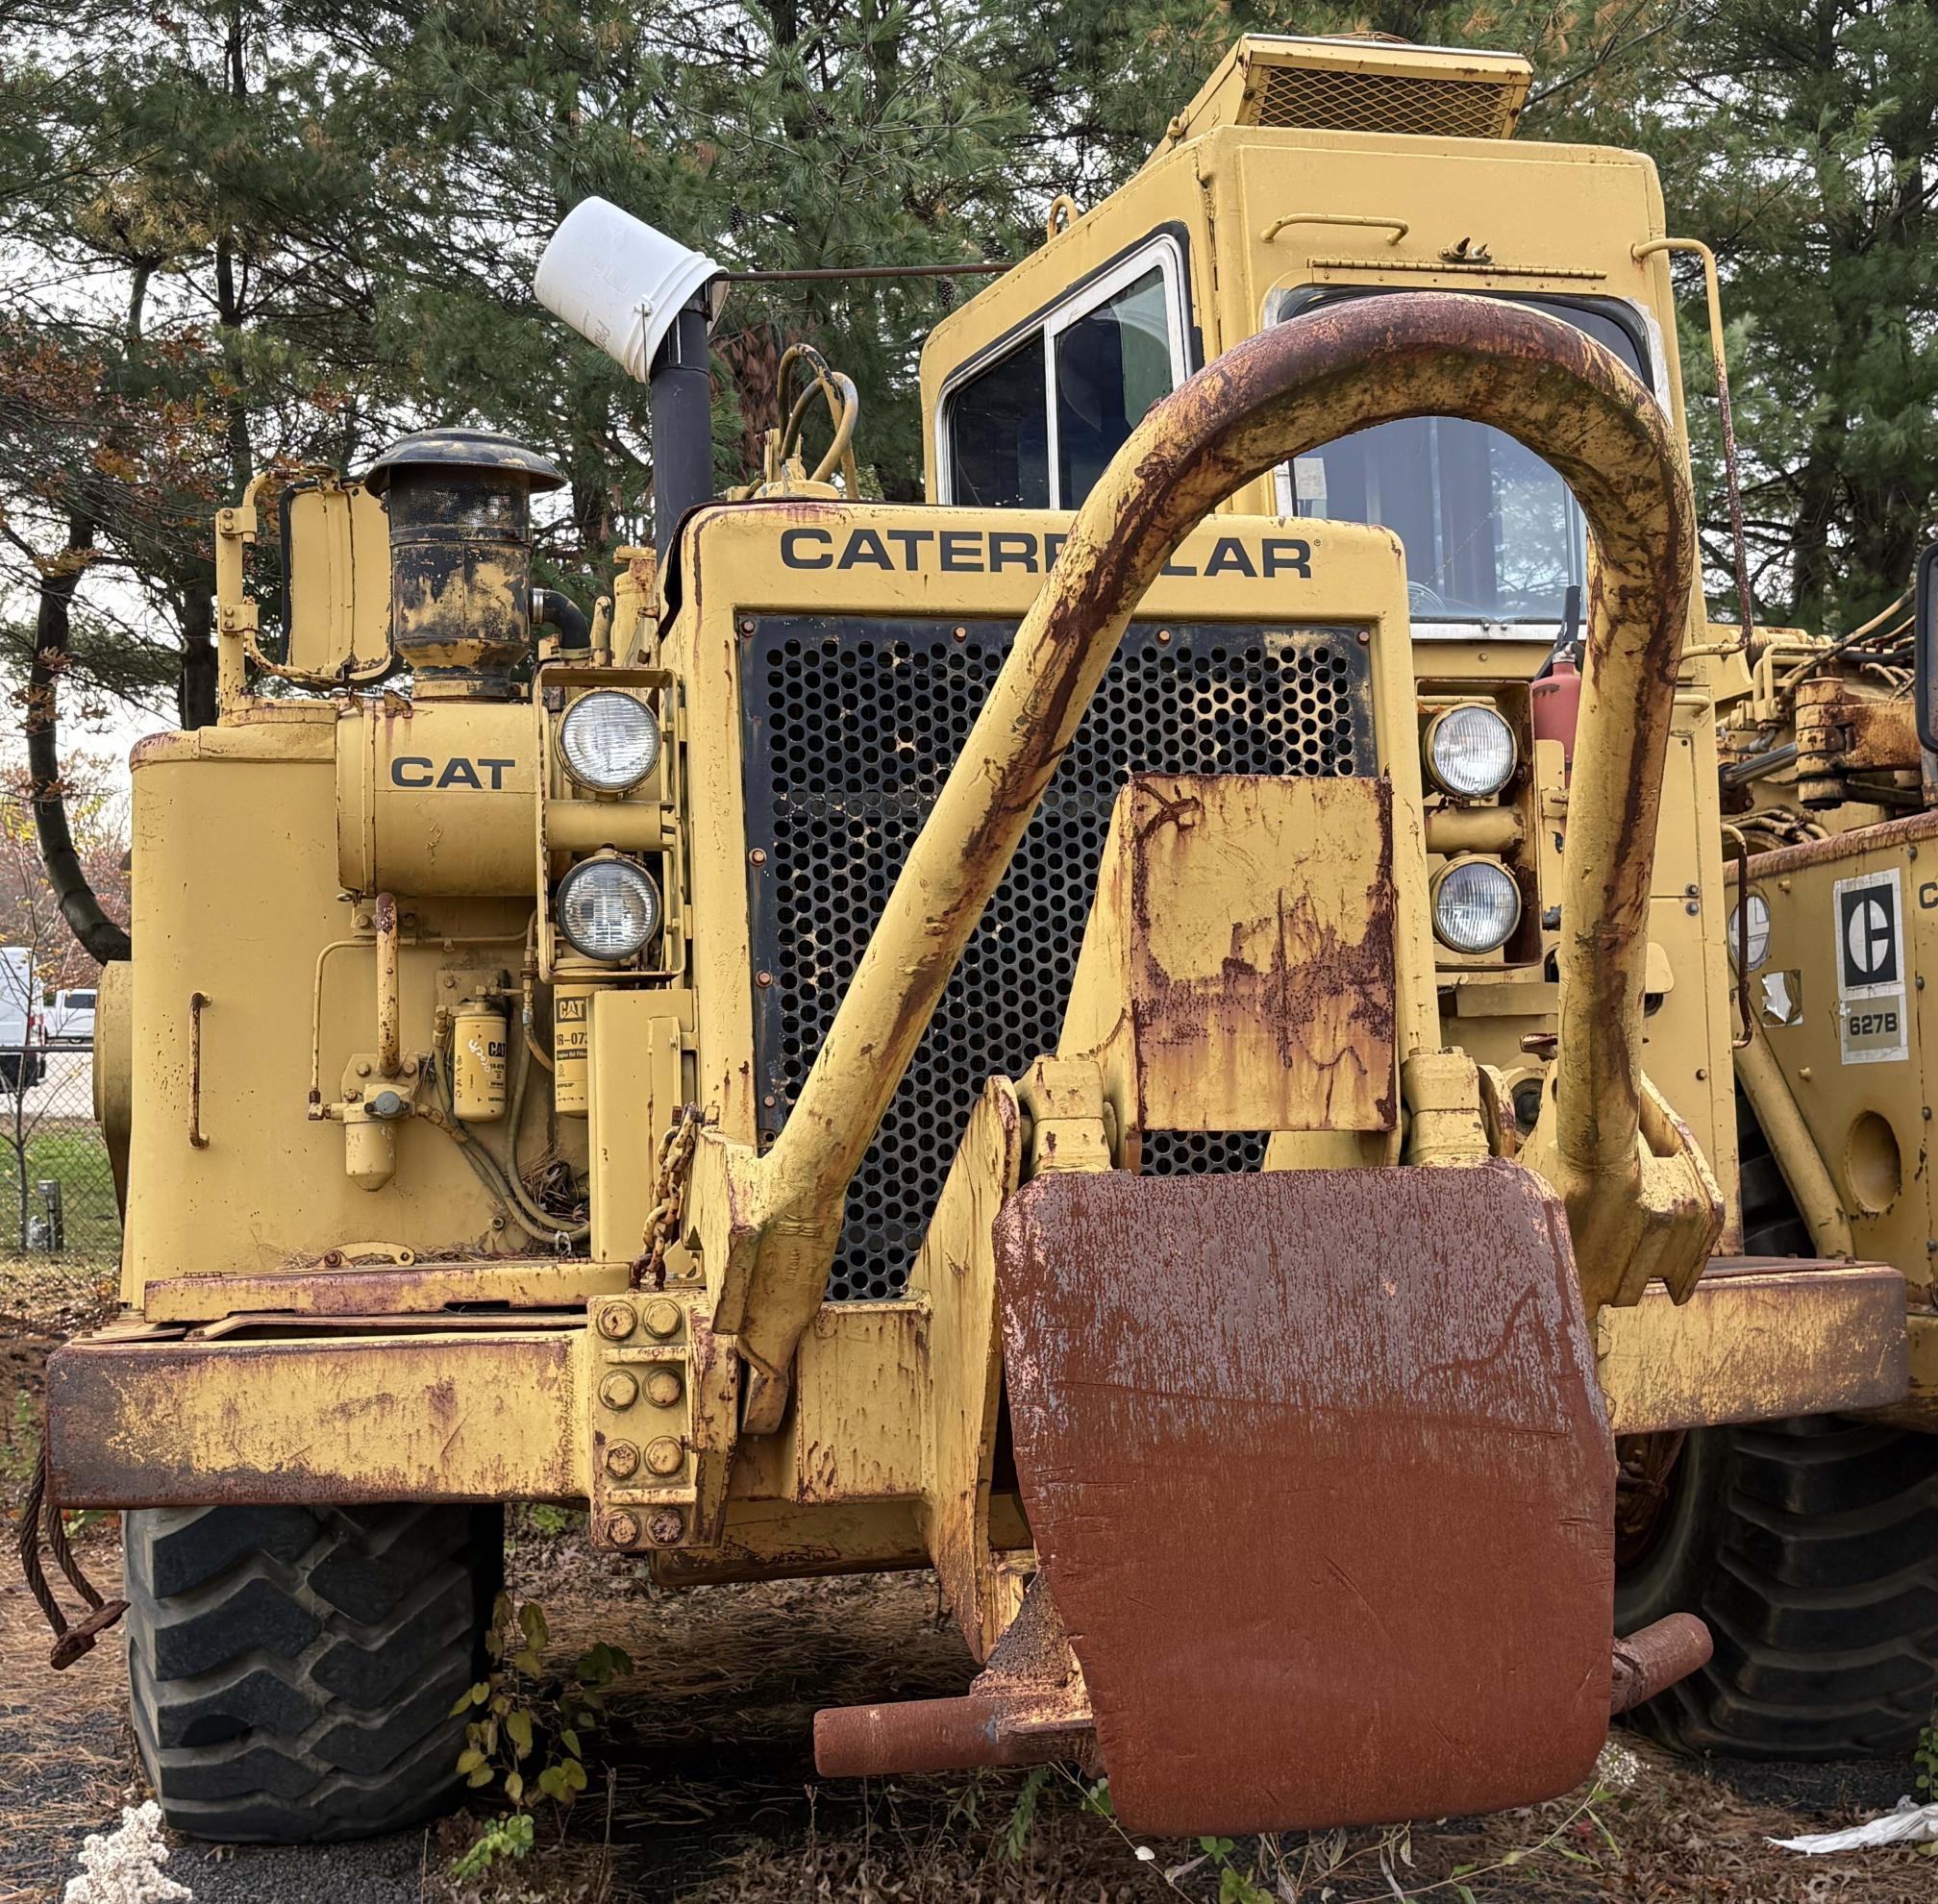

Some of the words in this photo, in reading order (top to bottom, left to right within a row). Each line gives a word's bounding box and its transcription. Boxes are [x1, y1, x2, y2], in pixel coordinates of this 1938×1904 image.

[391, 756, 515, 789] CAT
[559, 1000, 584, 1019] CAT
[1850, 1012, 1898, 1036] 627B
